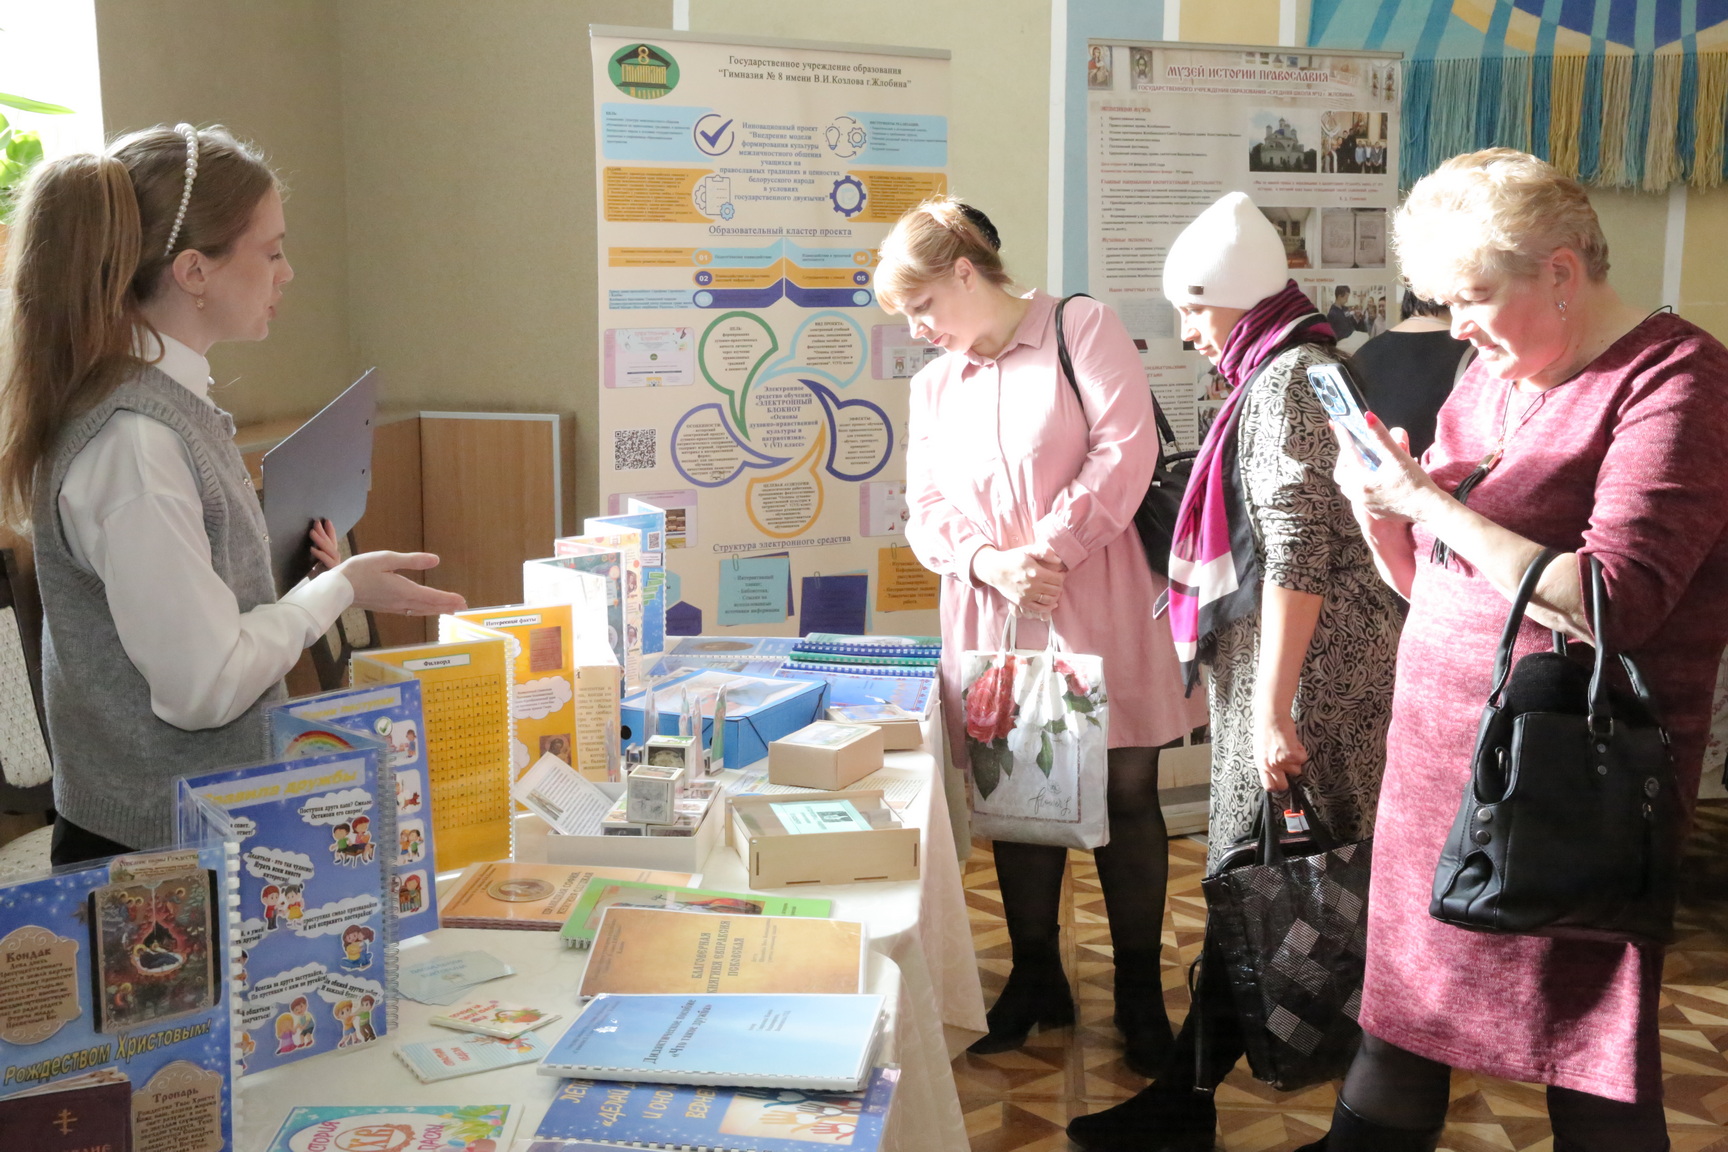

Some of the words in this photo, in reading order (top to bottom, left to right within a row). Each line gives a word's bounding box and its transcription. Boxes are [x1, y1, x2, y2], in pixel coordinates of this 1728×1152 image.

[638, 46, 649, 64] 8
[729, 56, 800, 69] Государственное
[802, 61, 850, 72] учреждение
[852, 63, 902, 75] образования
[1167, 65, 1205, 82] МУЗЕЙ
[1208, 66, 1256, 80] ИСТОРИИ
[1259, 69, 1328, 82] ПРАВОСЛАВИЯ
[718, 69, 764, 80] “Гимназия
[766, 72, 776, 80] №
[778, 72, 783, 80] 8
[785, 74, 811, 82] имени
[814, 74, 864, 86] В.И.Козлова
[1138, 85, 1192, 93] ГОСУДАРСТВЕННОГО
[742, 122, 795, 132] Инновационный
[741, 140, 788, 148] формирования
[739, 150, 793, 158] межличностного
[720, 168, 765, 176] православных
[768, 168, 800, 176] традициях
[748, 176, 792, 184] белорусского
[734, 194, 791, 202] государственного
[708, 225, 784, 235] Образовательный
[786, 228, 818, 236] кластер
[820, 228, 852, 236] проекта
[756, 398, 812, 406] «ЭЛЕКТРОННЫЙ
[750, 420, 818, 429] духовно-нравственной
[713, 543, 756, 553] Структура
[759, 539, 814, 548] электронного
[817, 536, 851, 545] средства
[519, 616, 537, 625] факты
[424, 658, 451, 668] Филворд
[284, 770, 358, 796] дружбы
[254, 862, 270, 872] Играть
[318, 918, 344, 928] исправить
[6, 948, 52, 964] Кондак
[692, 932, 712, 979] БЛАГОВЕРНАЯ
[727, 938, 744, 977] ПСКОВСКАЯ
[255, 984, 272, 992] Всегда
[280, 978, 294, 987] друга
[707, 961, 723, 994] КНЯГИНЯ
[643, 1020, 682, 1064] Дидактическое
[4, 1042, 112, 1086] Рождеством
[116, 1019, 213, 1063] Христовым!
[152, 1088, 198, 1104] Тропарь
[648, 1090, 674, 1111] ОНО
[598, 1088, 632, 1127] «ДЕЛАЙ
[307, 1121, 340, 1152] СТОРИЯ
